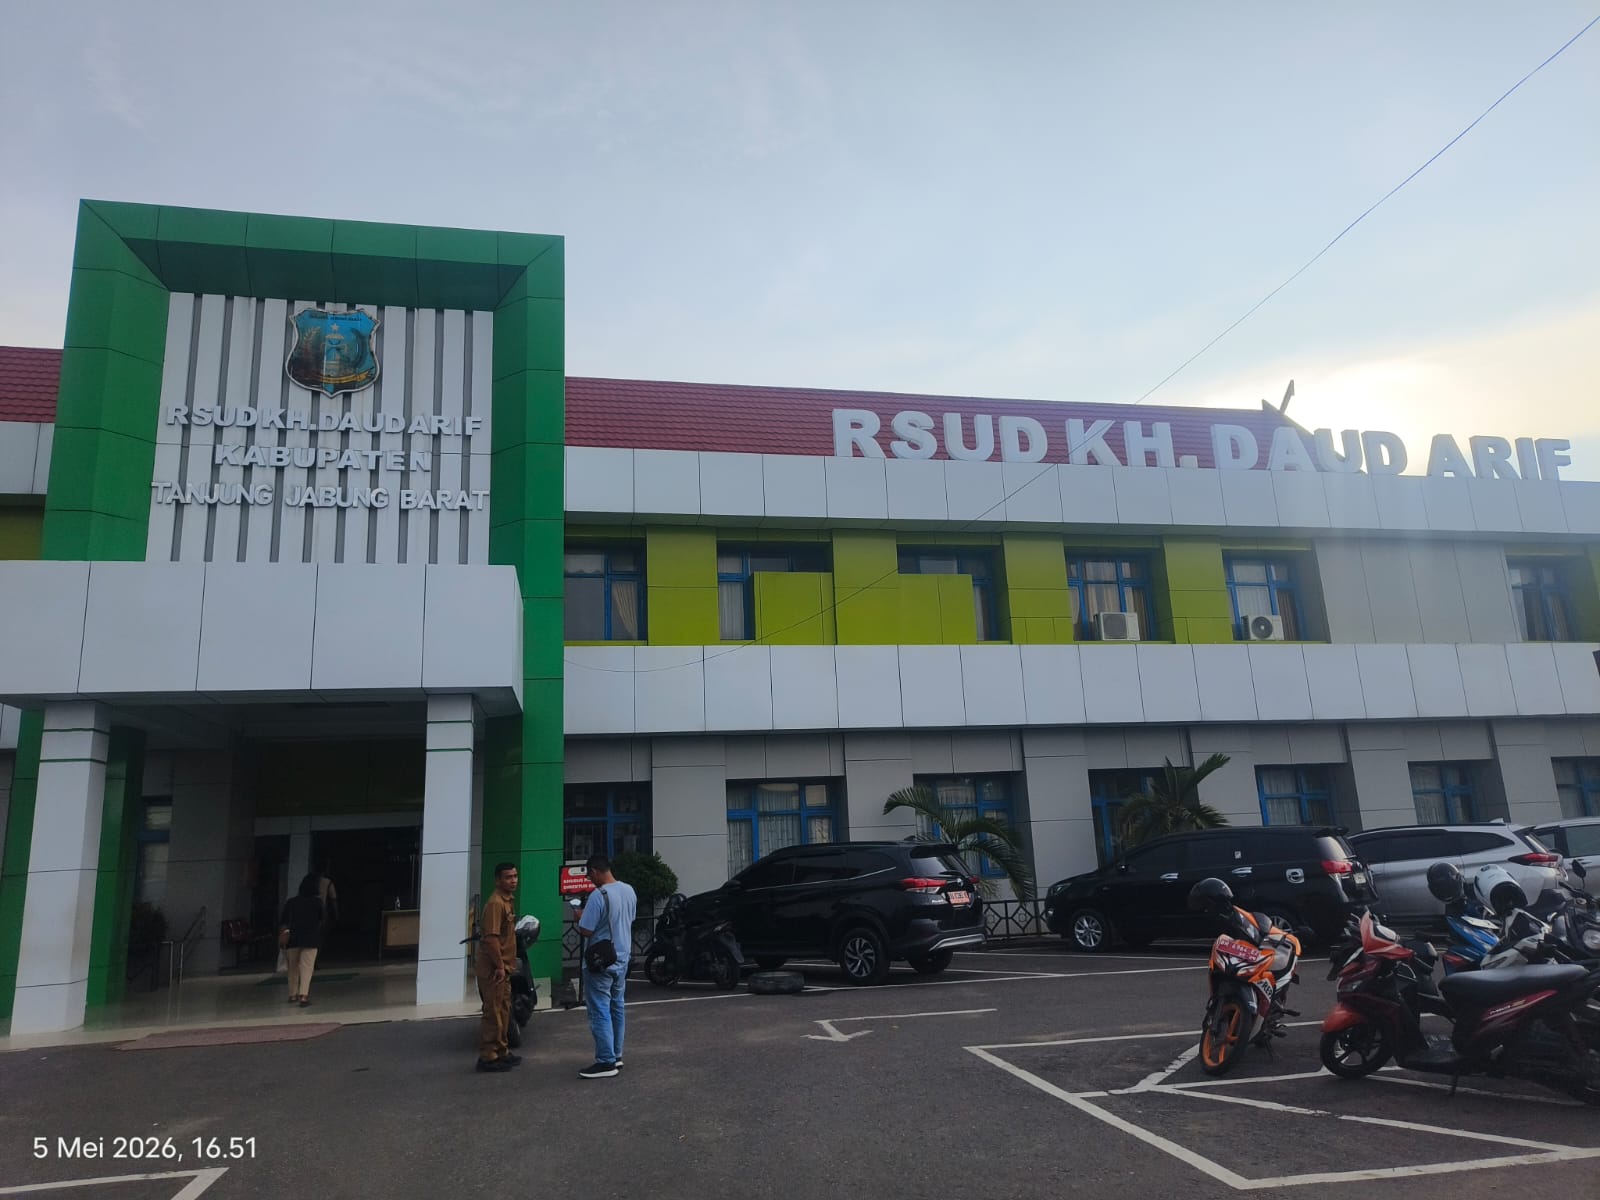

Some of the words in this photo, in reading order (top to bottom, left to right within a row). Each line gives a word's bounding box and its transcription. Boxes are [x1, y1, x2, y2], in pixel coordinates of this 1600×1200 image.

[167, 405, 258, 428] RSUD
[408, 414, 482, 436] ARIF
[214, 444, 432, 472] KABUPATEN
[832, 408, 1048, 463] RSUD
[1065, 418, 1198, 468] KH.
[1210, 423, 1408, 475] DAUD
[1426, 433, 1571, 481] ARIF
[151, 481, 273, 506] TANJUNG
[285, 486, 389, 509] JABUNG
[400, 489, 490, 511] BARAT
